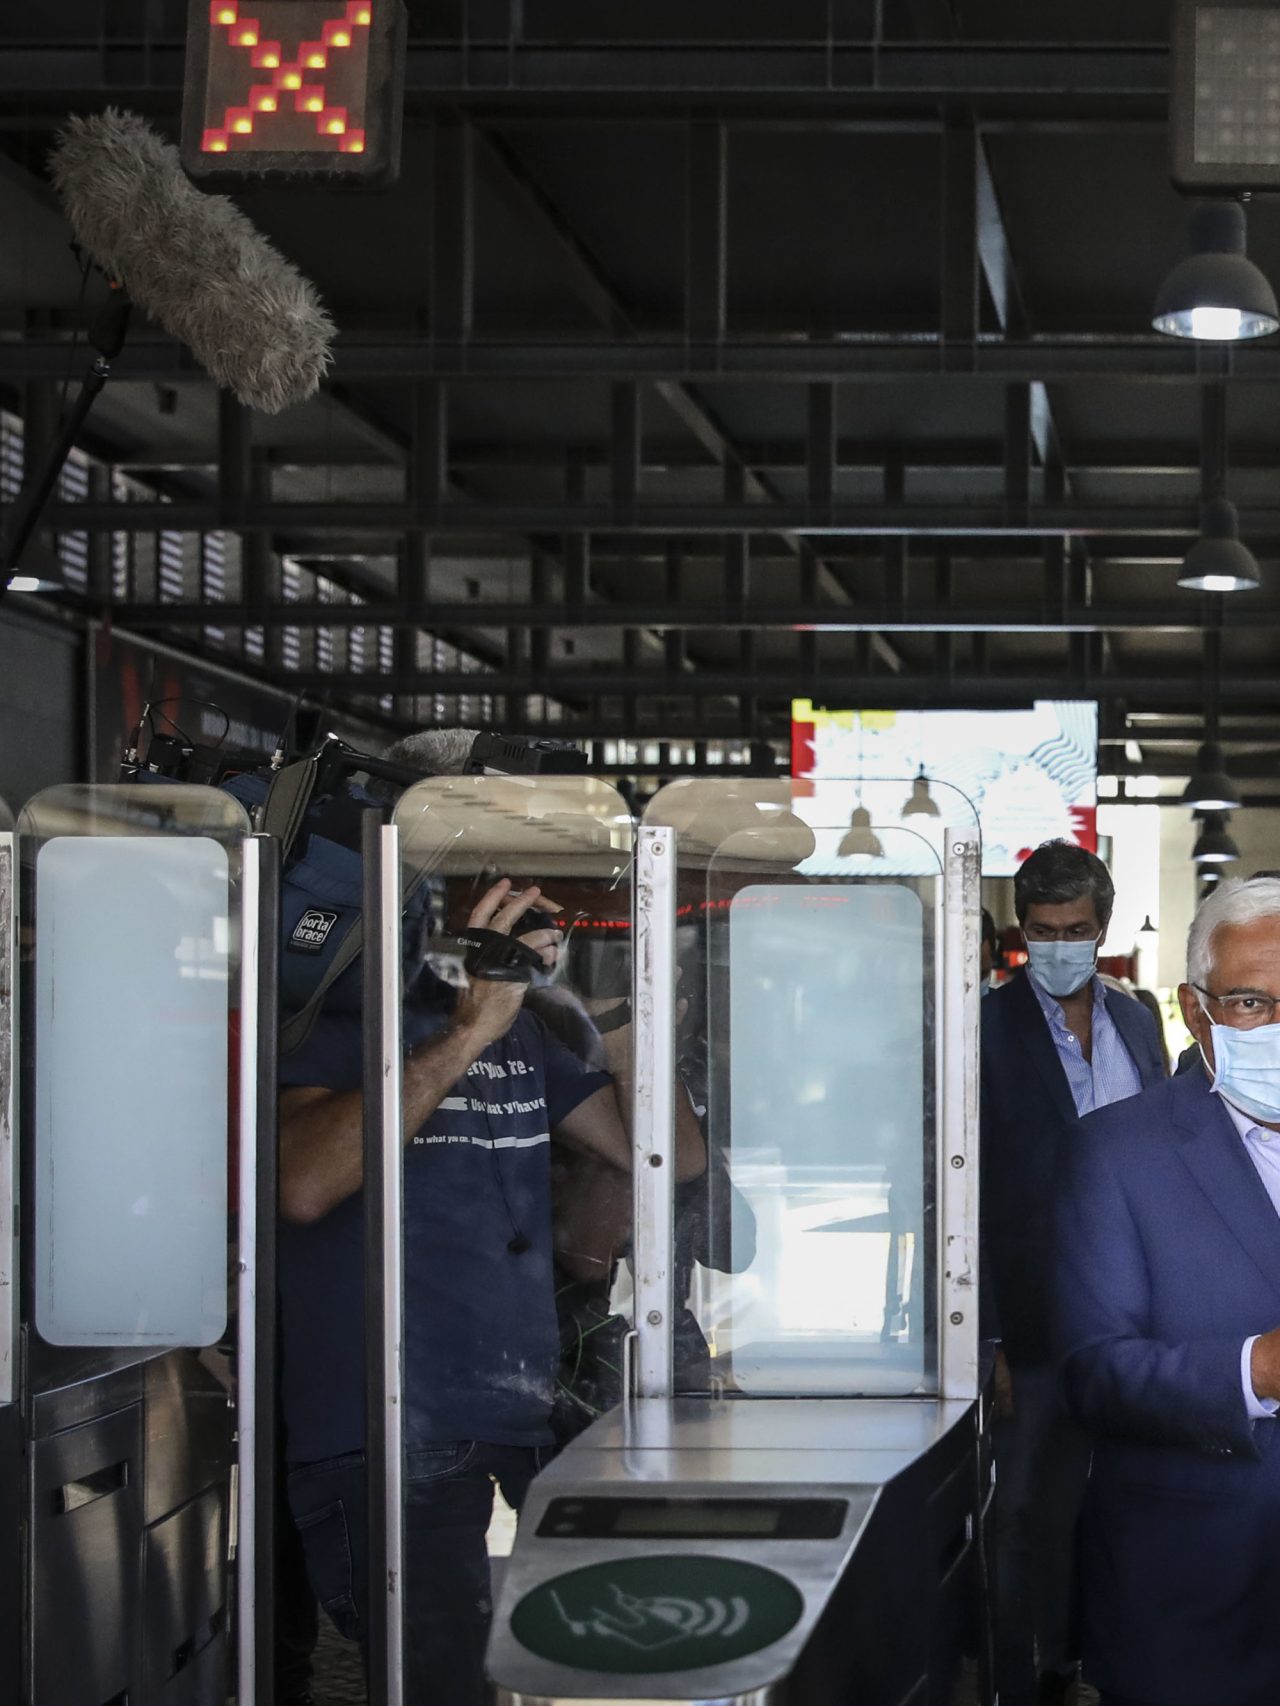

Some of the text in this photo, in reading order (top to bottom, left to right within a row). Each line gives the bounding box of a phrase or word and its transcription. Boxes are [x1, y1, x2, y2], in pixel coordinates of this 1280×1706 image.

[300, 917, 329, 931] porta
[295, 927, 325, 942] brace
[414, 1136, 424, 1145] Do
[426, 1135, 446, 1144] what
